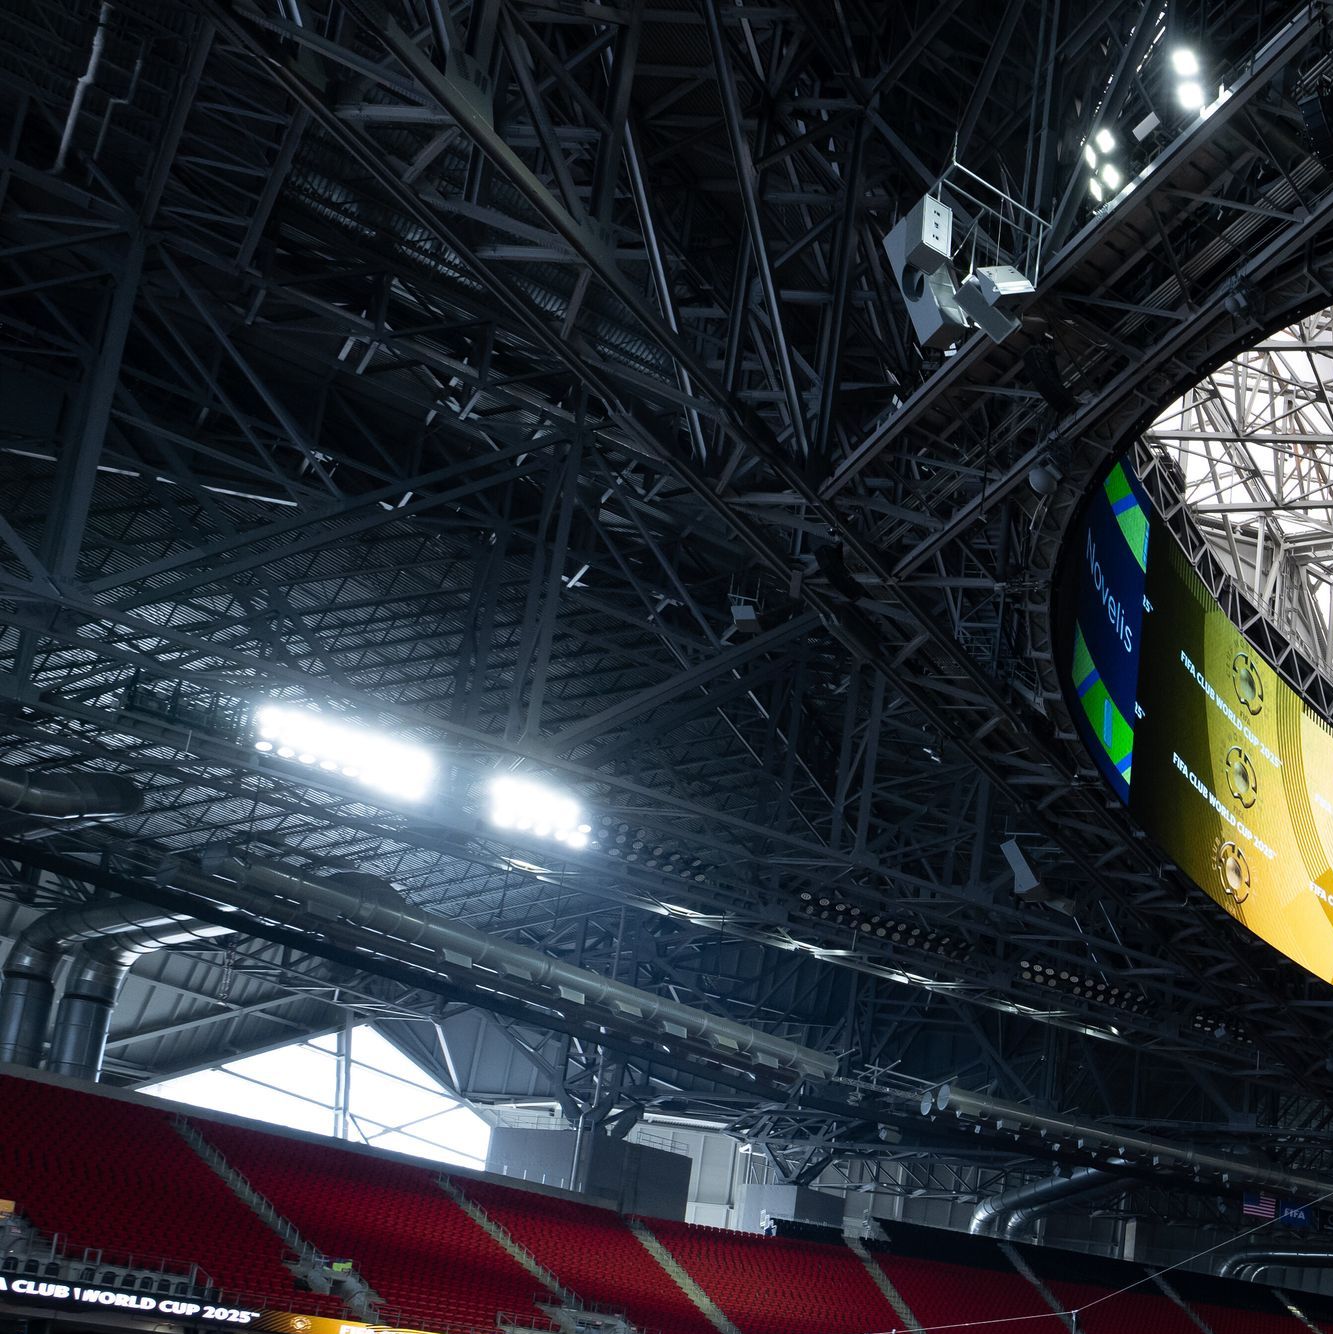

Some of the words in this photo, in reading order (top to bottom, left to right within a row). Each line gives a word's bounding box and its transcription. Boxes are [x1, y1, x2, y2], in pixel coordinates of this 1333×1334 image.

[1086, 527, 1132, 653] Novelis
[1181, 650, 1196, 679] FIFA
[1197, 672, 1215, 700] CLUB
[1216, 697, 1242, 731] WORLD
[1243, 727, 1259, 747] CUP
[1173, 752, 1188, 778] FIFA
[1190, 772, 1208, 799] CLUB
[1209, 795, 1236, 827] WORLD
[1237, 821, 1253, 840] CUP
[12, 1280, 70, 1299] CLUB
[82, 1288, 156, 1310] WORLD
[159, 1300, 200, 1315] CUP
